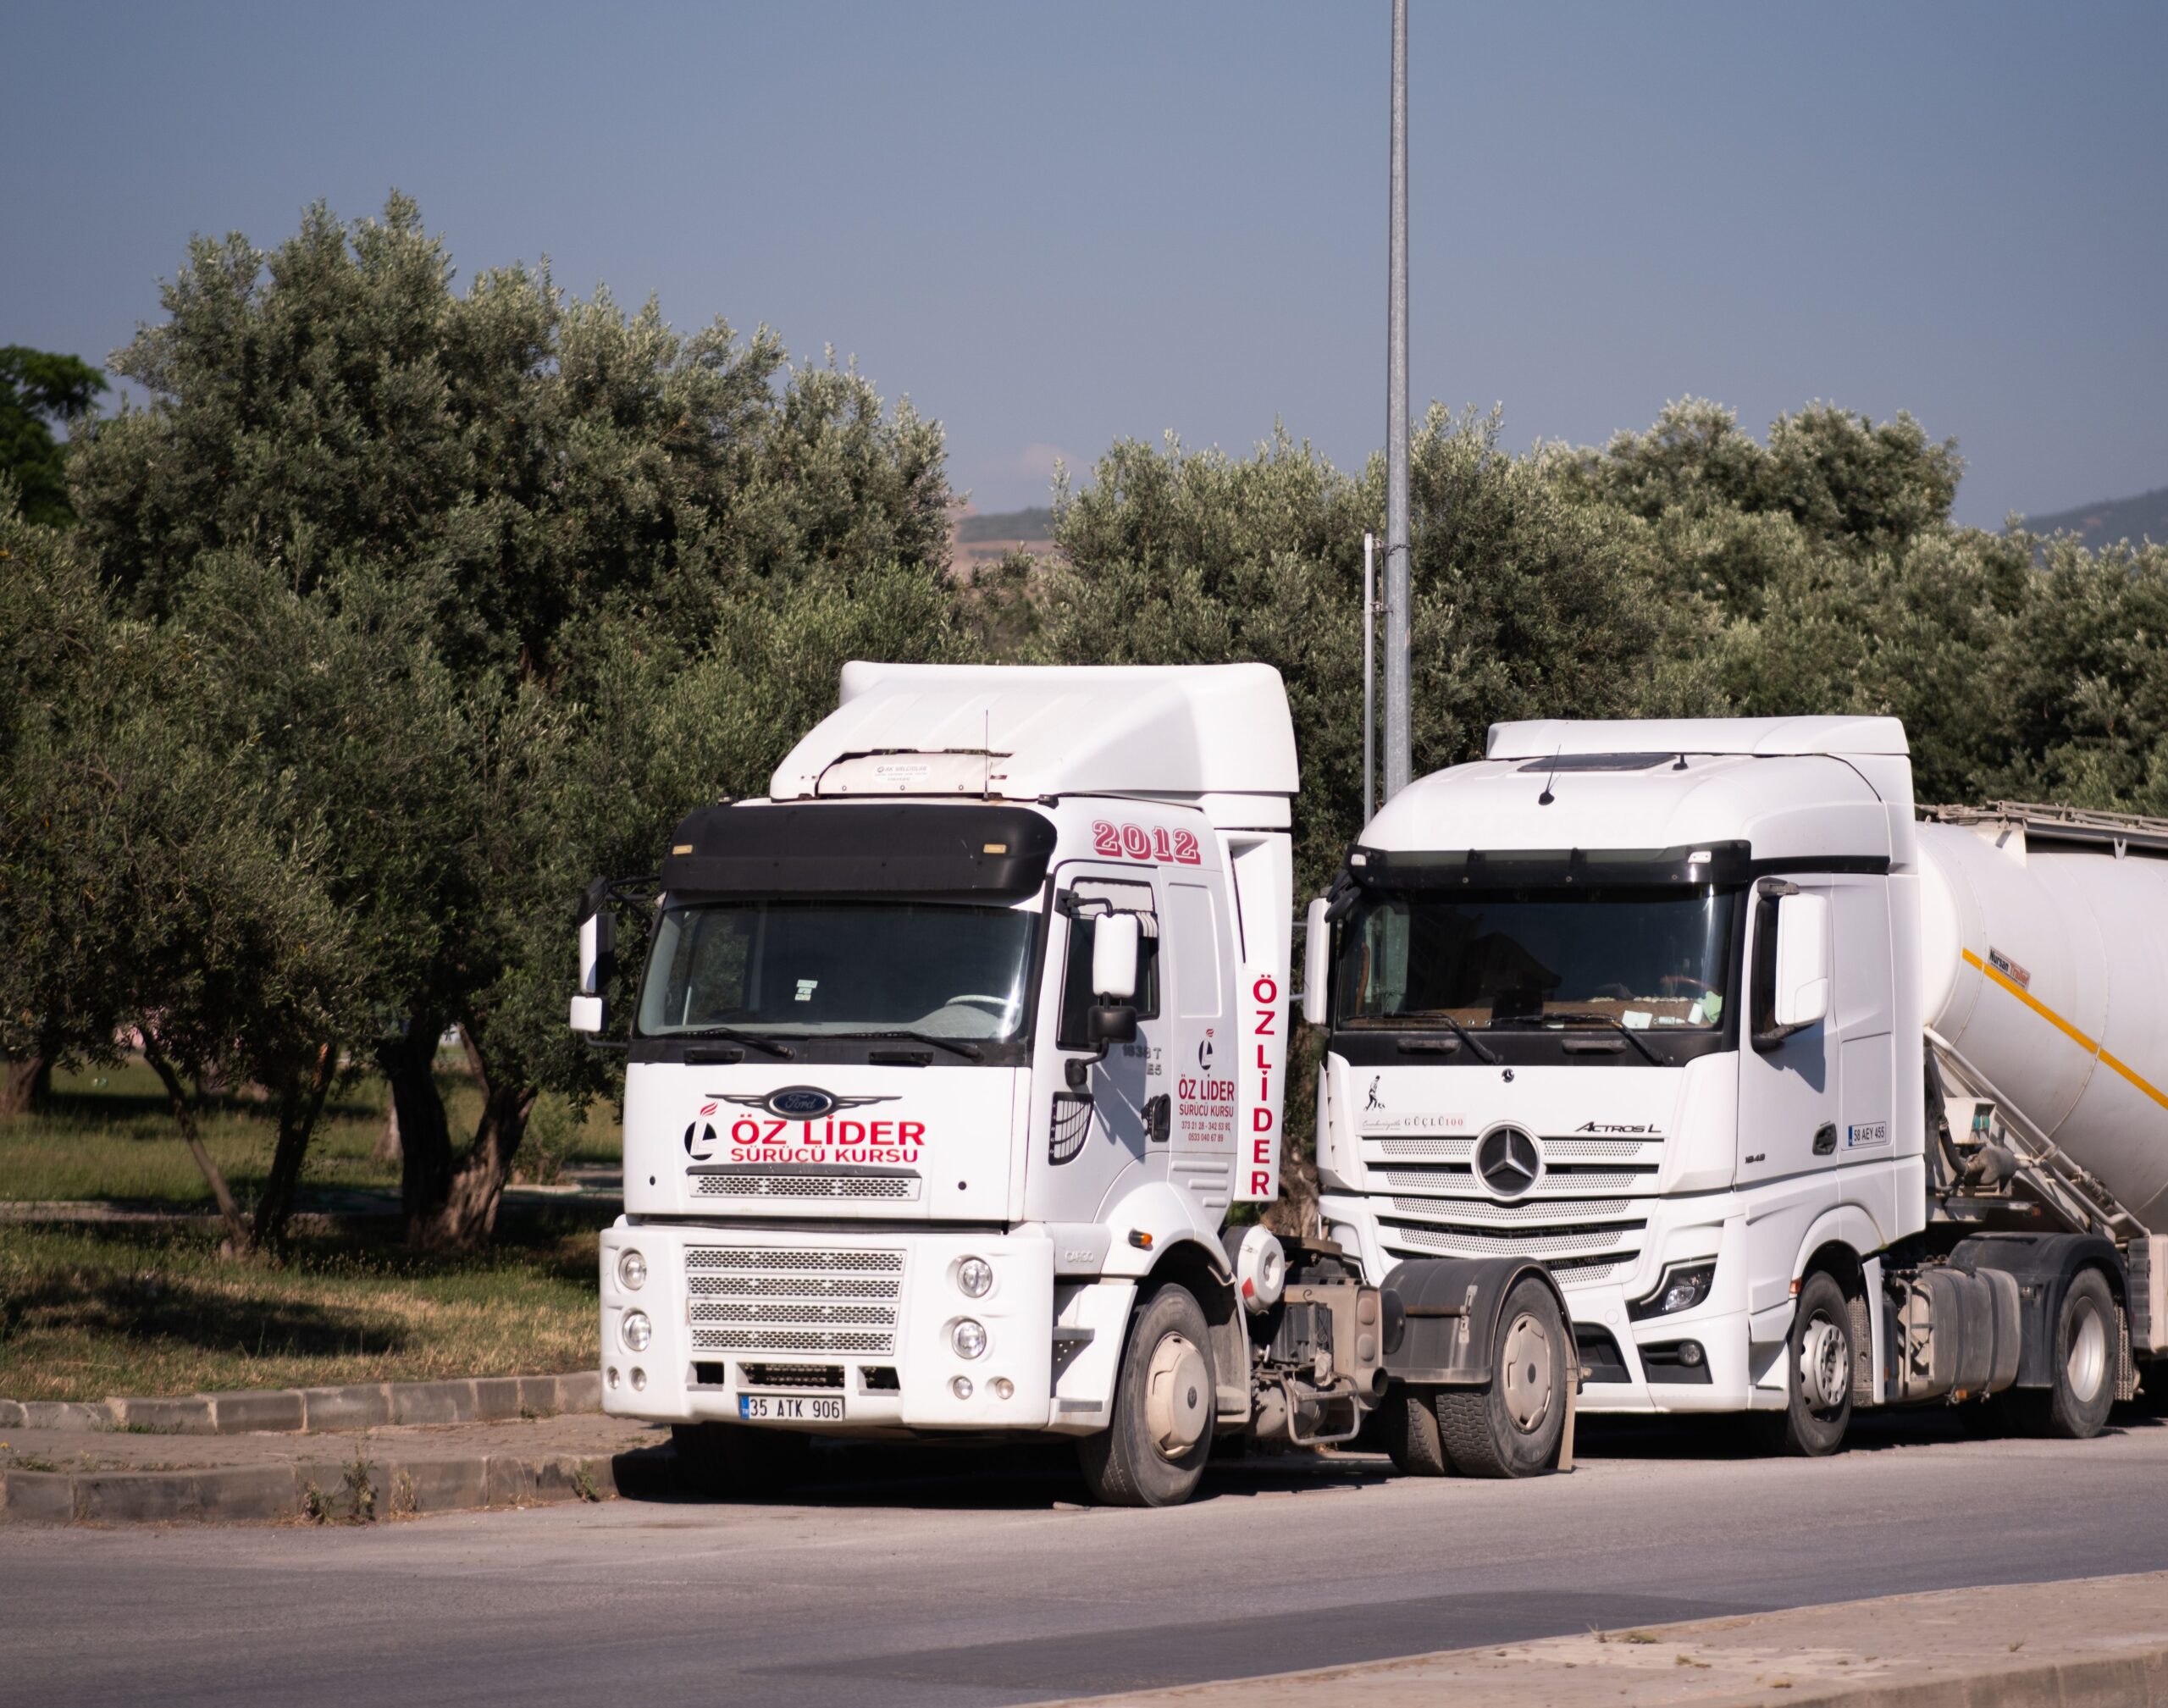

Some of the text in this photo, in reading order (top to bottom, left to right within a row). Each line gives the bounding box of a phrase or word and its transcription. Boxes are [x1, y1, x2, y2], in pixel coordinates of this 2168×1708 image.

[1092, 819, 1201, 865] 2012
[1989, 948, 2009, 973] Nursan
[1153, 1047, 1162, 1060] T
[1147, 1063, 1162, 1075] E5
[1178, 1073, 1235, 1102] ÖZ LİDER
[785, 1093, 817, 1110] Ford
[1179, 1102, 1234, 1118] SÜRÜCÜ KURSU
[731, 1113, 926, 1147] ÖZ LİDER
[1181, 1120, 1191, 1130] 373
[1191, 1121, 1197, 1130] 21
[1208, 1121, 1218, 1131] 342
[1218, 1122, 1225, 1131] 53
[1647, 1123, 1662, 1134] L
[1853, 1125, 1885, 1142] 58 AEY 455
[1201, 1133, 1210, 1142] 040
[1211, 1133, 1217, 1142] 67
[731, 1145, 919, 1164] SÜRÜCÜ KURSU
[749, 1398, 768, 1417] 35
[777, 1399, 804, 1418] ATK
[812, 1399, 840, 1419] 906
